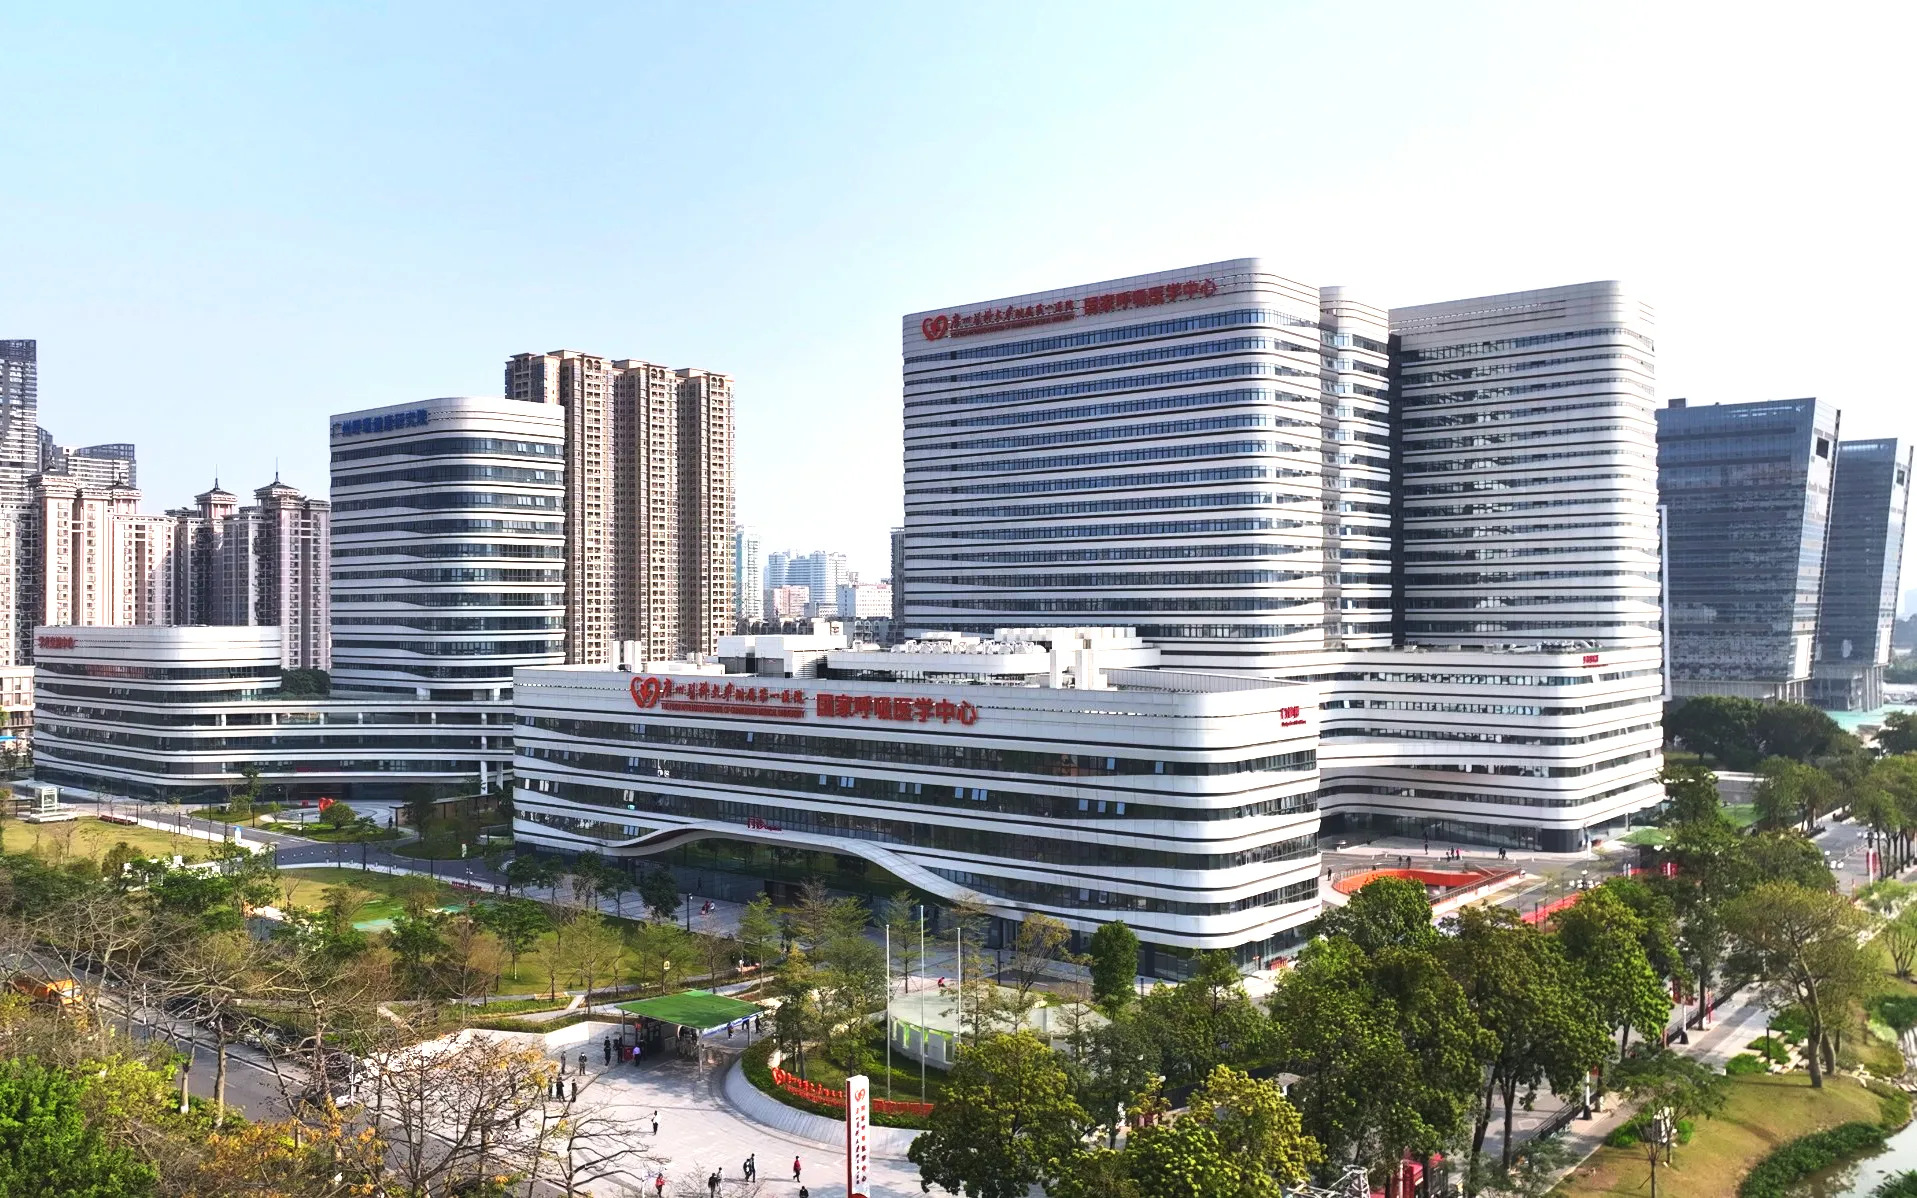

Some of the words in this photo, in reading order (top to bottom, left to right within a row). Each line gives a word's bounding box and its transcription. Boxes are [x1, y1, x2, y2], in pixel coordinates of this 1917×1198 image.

[817, 694, 978, 725] 国家呼吸医学中心
